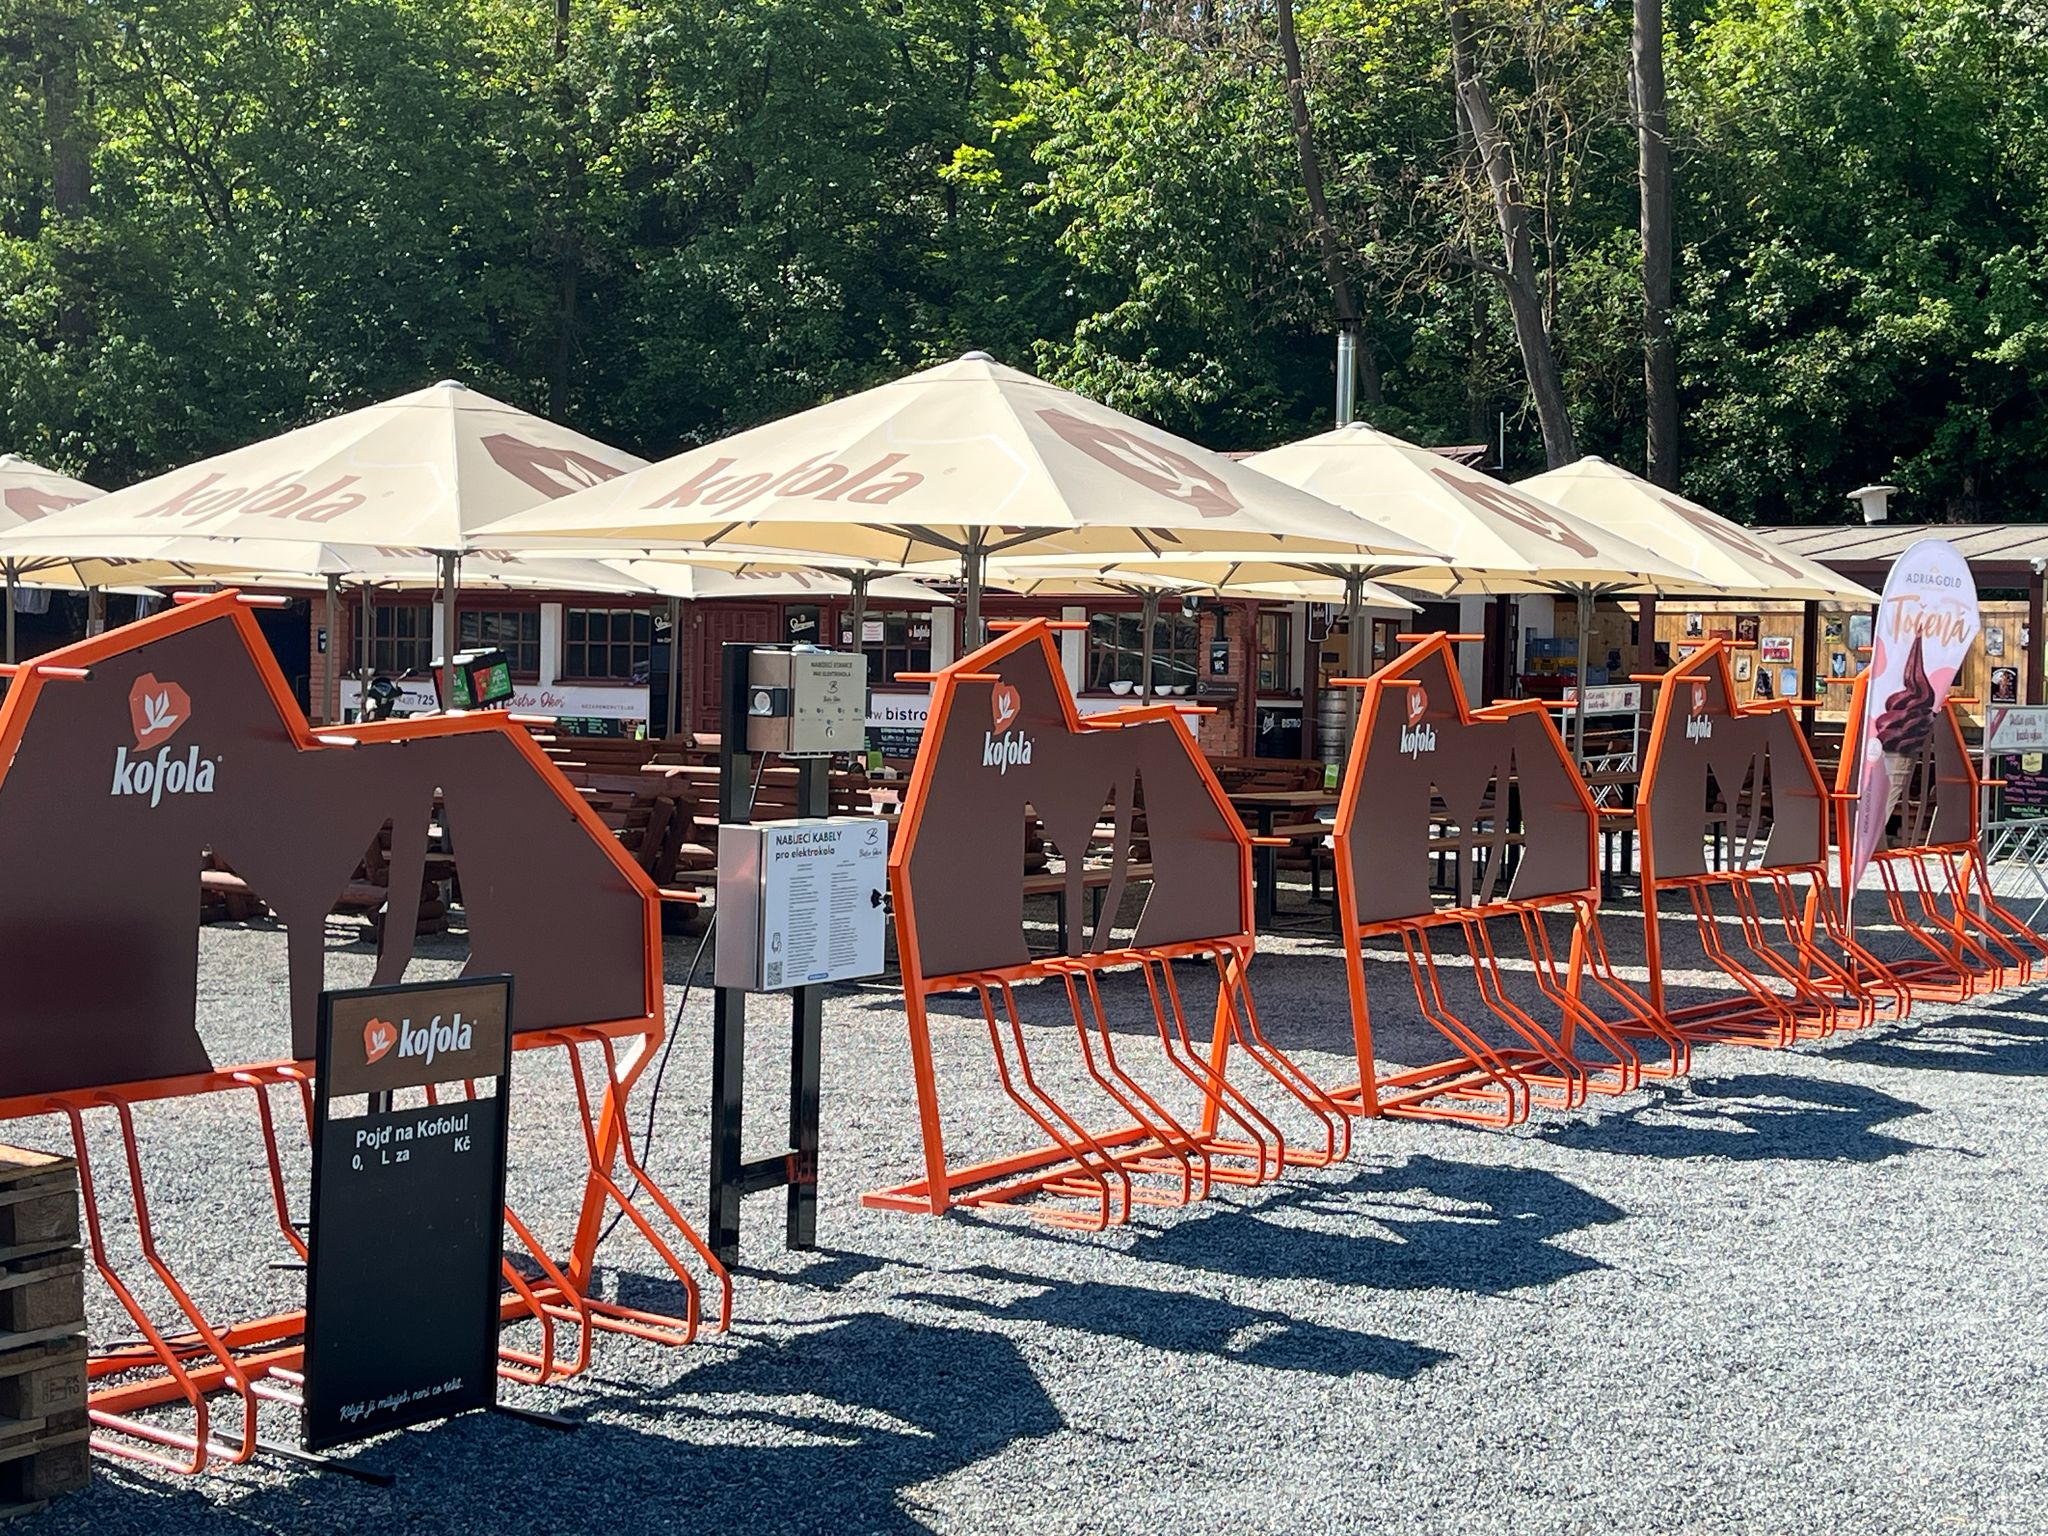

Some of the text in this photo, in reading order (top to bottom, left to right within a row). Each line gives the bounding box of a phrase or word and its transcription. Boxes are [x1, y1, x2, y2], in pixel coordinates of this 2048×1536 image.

[135, 471, 366, 527] kofola
[640, 450, 924, 517] kofola
[1887, 595, 1972, 647] Točená
[417, 695, 435, 706] 725
[886, 707, 927, 720] bistro
[1400, 723, 1436, 760] kofola
[1686, 714, 1711, 745] kofola
[983, 730, 1032, 775] kofola
[111, 745, 215, 808] kofola
[776, 845, 835, 861] pro elektrokola
[812, 830, 843, 842] KABELY
[398, 1013, 473, 1065] kofola
[356, 1113, 469, 1150] Pojď na Kofolu!
[381, 1151, 390, 1165] L
[396, 1149, 410, 1163] za
[454, 1135, 471, 1152] Kč
[432, 1385, 442, 1395] co
